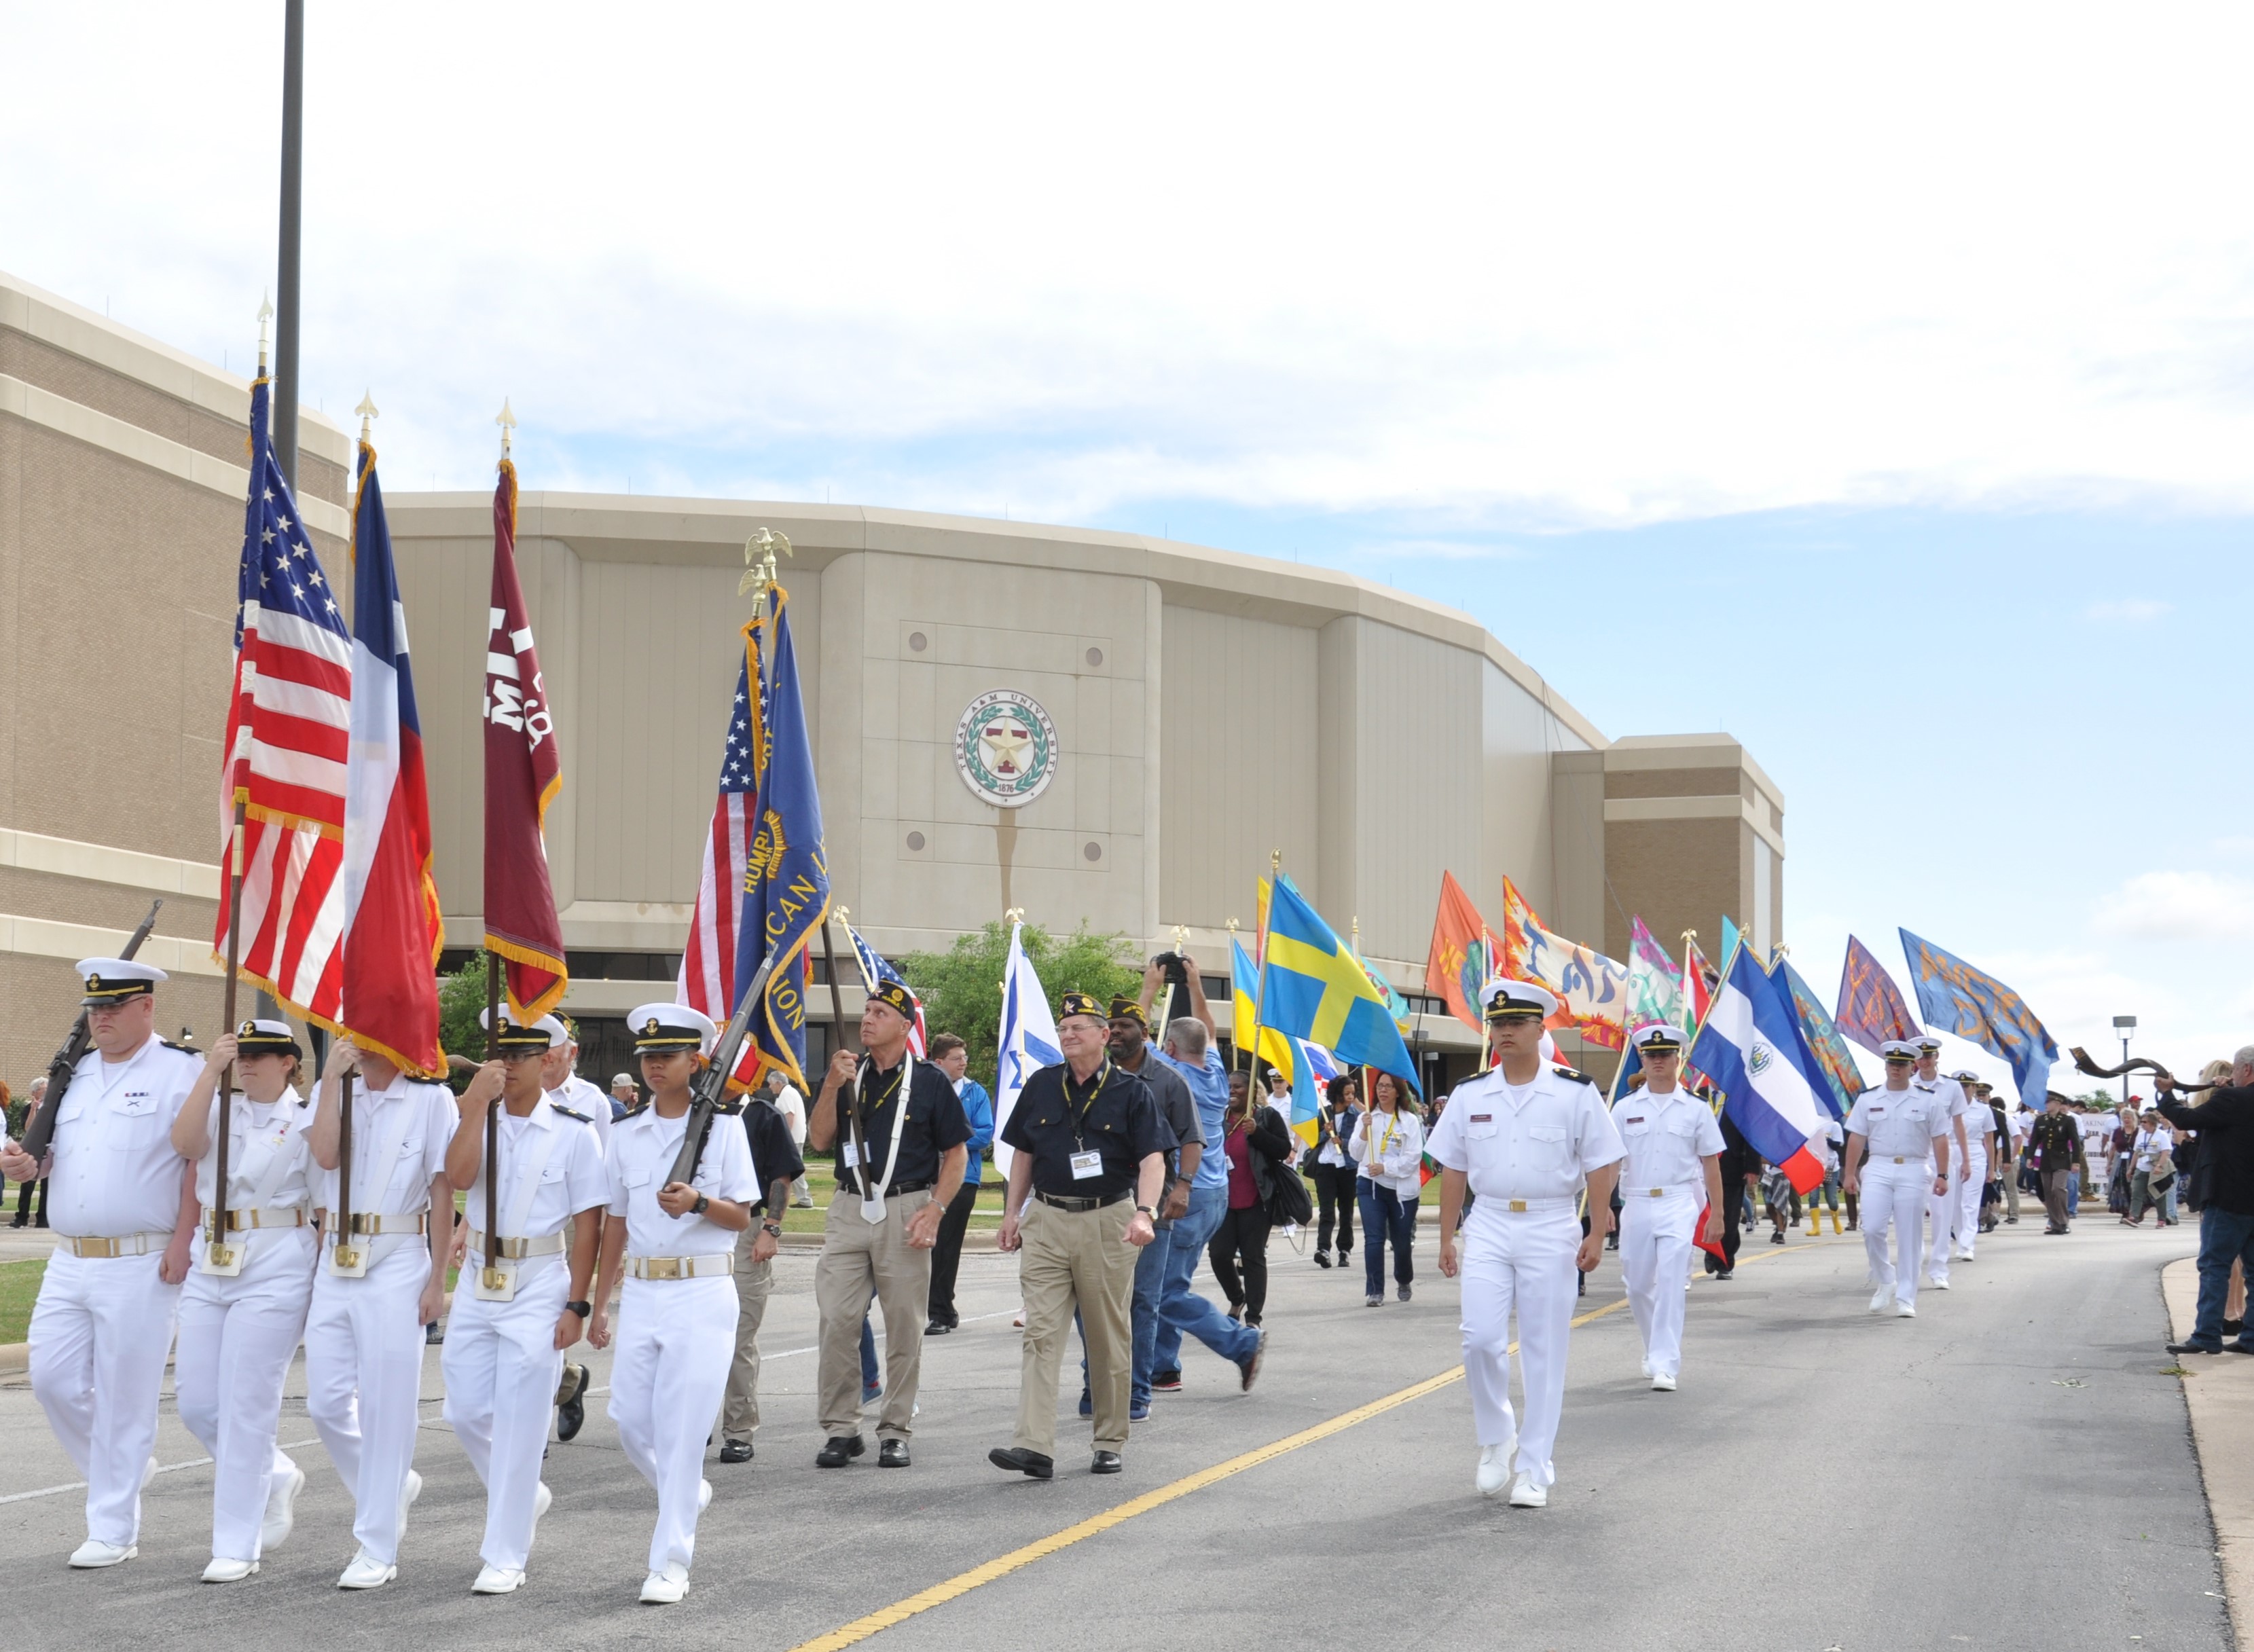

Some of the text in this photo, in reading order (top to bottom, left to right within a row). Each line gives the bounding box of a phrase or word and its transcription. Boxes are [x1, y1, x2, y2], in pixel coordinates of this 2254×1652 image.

[956, 693, 1057, 777] TEXAS A&M UNIVERSITY
[998, 783, 1015, 793] 1876
[765, 874, 818, 946] ICAN
